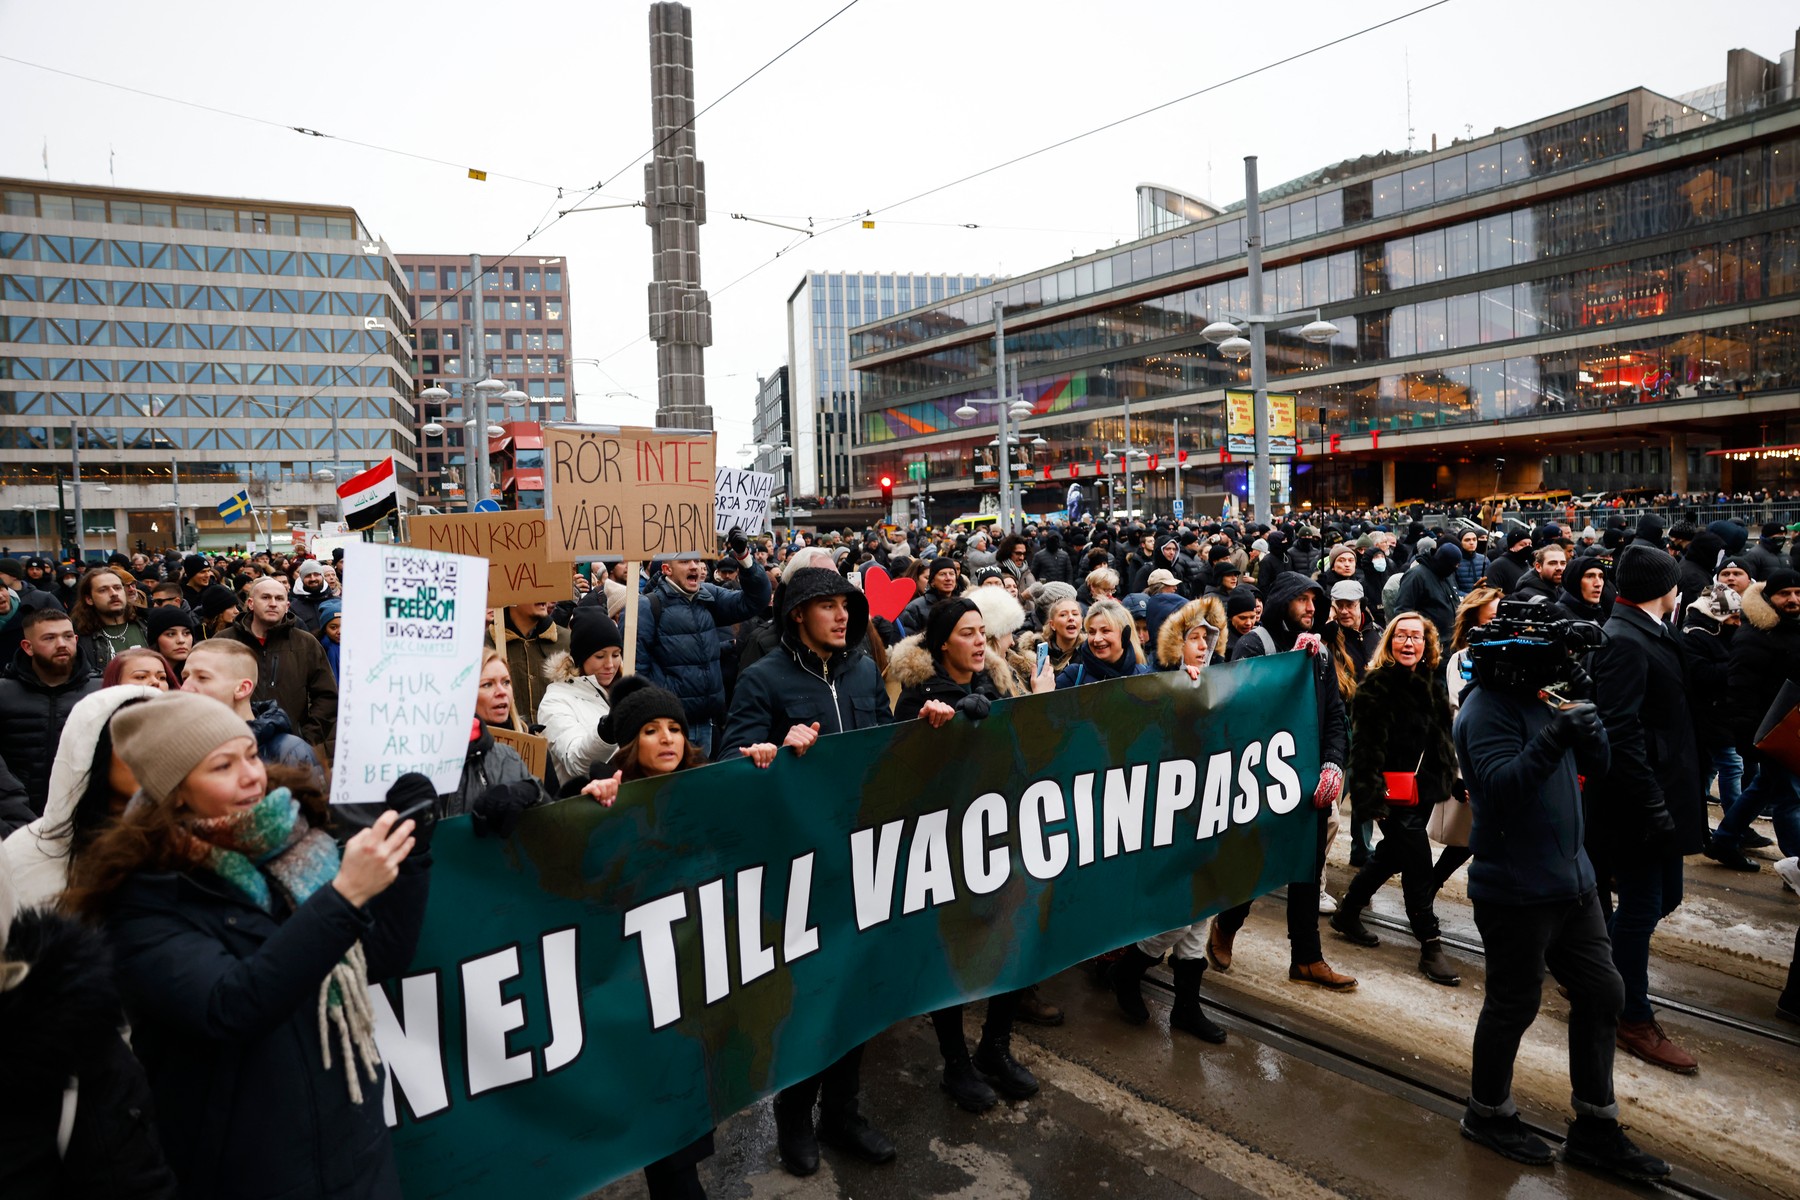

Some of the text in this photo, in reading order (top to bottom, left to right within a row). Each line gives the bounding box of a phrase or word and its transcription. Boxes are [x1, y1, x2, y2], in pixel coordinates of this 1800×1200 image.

[555, 433, 710, 484] RÖR INTE
[151, 521, 158, 533] 4
[429, 521, 481, 555] MIN
[557, 500, 715, 554] VÅRA BARN!
[504, 561, 554, 591] VAL
[417, 587, 437, 601] NO
[385, 596, 455, 622] FREEDOM
[385, 640, 454, 653] VACCINATED
[388, 672, 441, 695] HUR
[421, 731, 444, 754] DU
[336, 791, 349, 801] 10
[367, 730, 1302, 1128] NEJ TILL VACCINPASS
